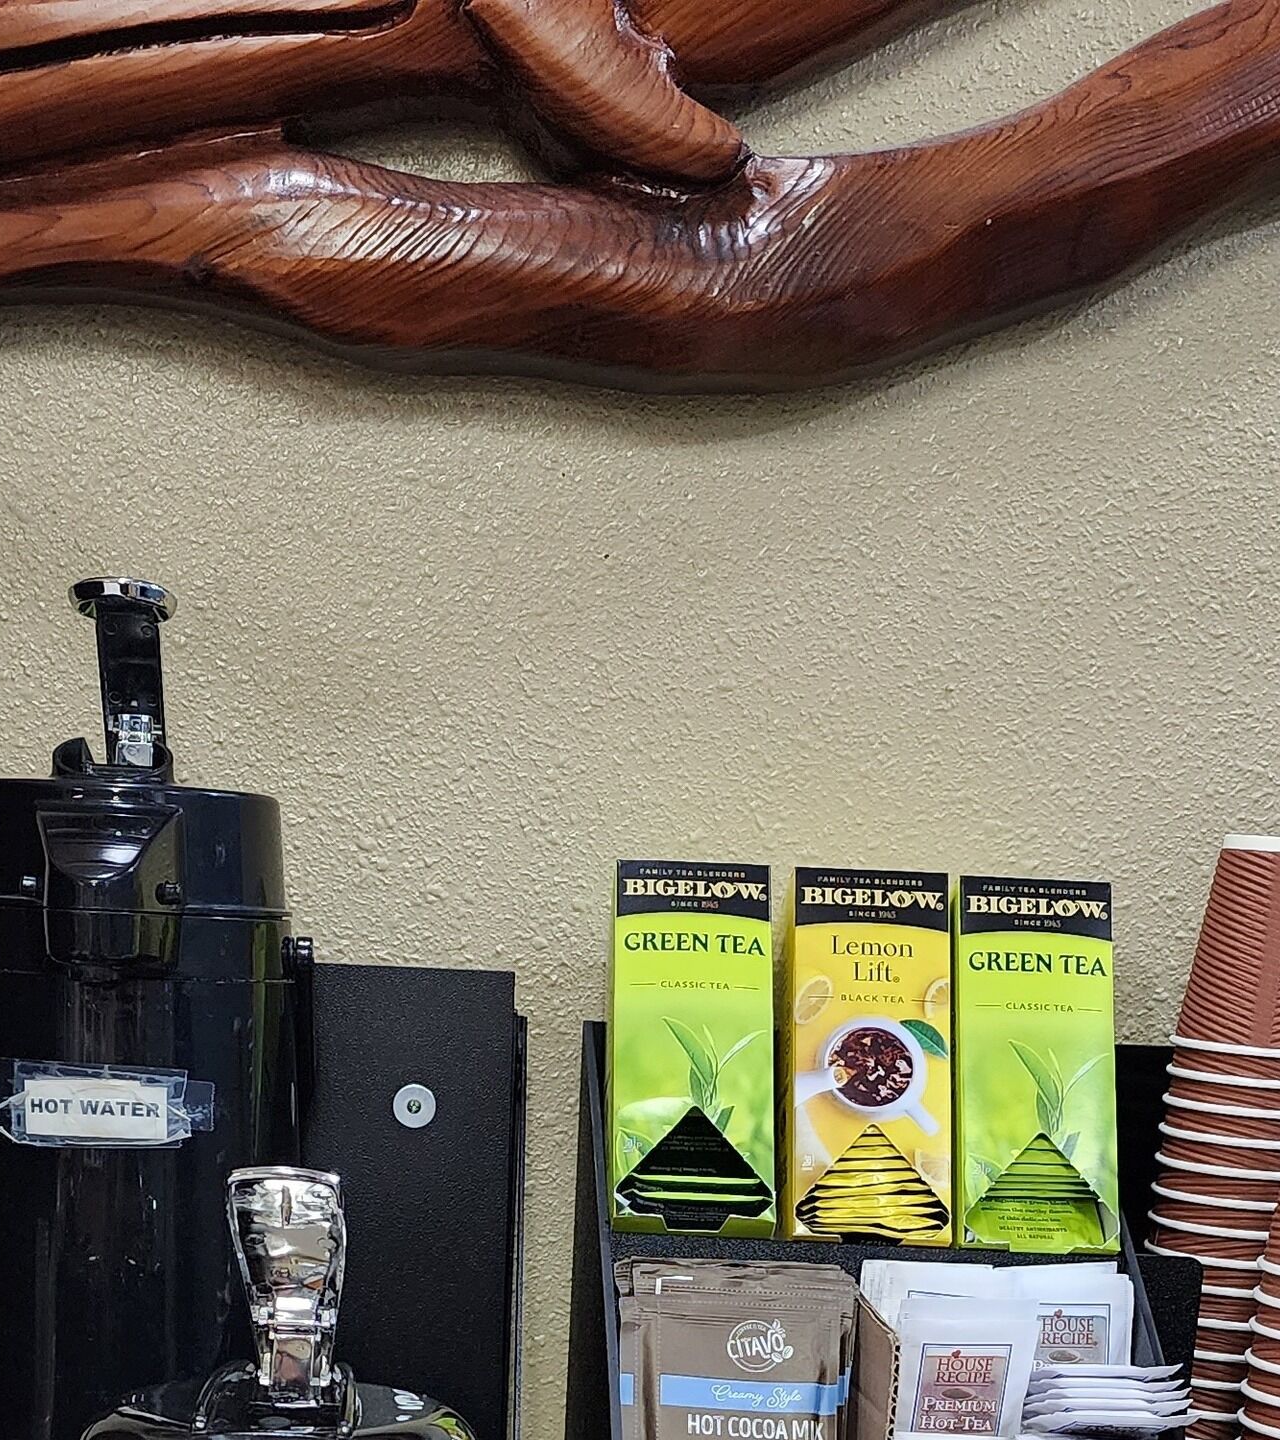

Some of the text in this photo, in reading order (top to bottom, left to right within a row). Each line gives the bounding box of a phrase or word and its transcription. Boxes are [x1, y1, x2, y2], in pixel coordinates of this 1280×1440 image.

[697, 870, 746, 878] BLENDERS
[817, 876, 851, 884] FAMILY
[874, 878, 923, 887] BLENDERS
[622, 878, 767, 901] BIGELOW
[801, 886, 943, 910] BIGELOW
[982, 884, 1087, 896] FAMILY TEA BLENDERS
[966, 895, 1107, 920] BIGELOW
[624, 932, 766, 956] GREEN TEA
[831, 935, 913, 957] Lemon
[853, 961, 892, 982] Lift
[969, 952, 1107, 977] GREEN TEA
[660, 980, 730, 990] CLASSIC TEA
[841, 994, 905, 1004] BLACK TEA
[1005, 1002, 1074, 1012] CLASSIC TEA
[30, 1098, 160, 1118] HOT WATER
[1042, 1317, 1094, 1333] HOUSE
[726, 1329, 785, 1360] CITAVO
[1041, 1332, 1093, 1346] RECIPE
[937, 1358, 994, 1372] HOUSE
[936, 1371, 991, 1384] RECIPE
[711, 1384, 802, 1408] Creamy Style
[921, 1396, 996, 1413] PREMIUM
[687, 1413, 724, 1436] HOT
[728, 1416, 788, 1440] COCOA
[920, 1415, 992, 1431] HOT TEA
